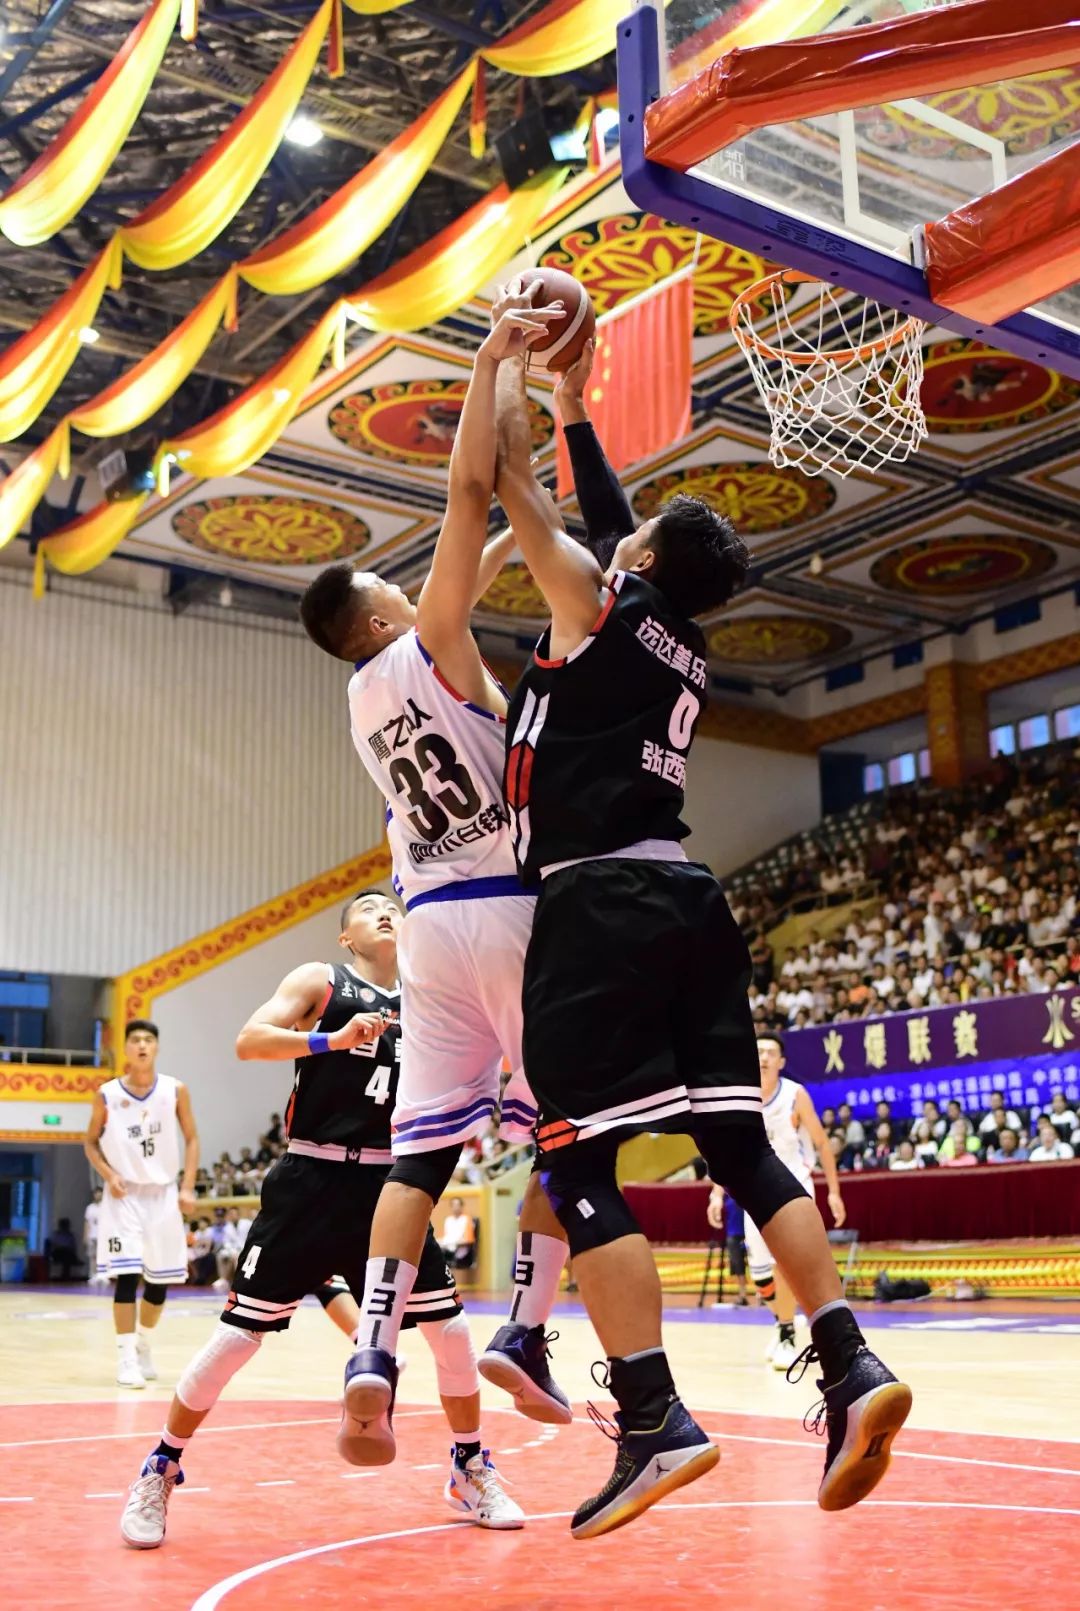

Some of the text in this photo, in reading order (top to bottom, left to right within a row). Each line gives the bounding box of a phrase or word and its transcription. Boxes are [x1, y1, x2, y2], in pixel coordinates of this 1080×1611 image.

[635, 616, 707, 689] 远达美乐
[668, 682, 700, 749] 0
[641, 740, 686, 788] 张西
[389, 733, 481, 843] 33
[364, 1065, 392, 1105] 4
[140, 1137, 155, 1157] 15
[108, 1237, 122, 1252] 15
[242, 1245, 263, 1279] 4
